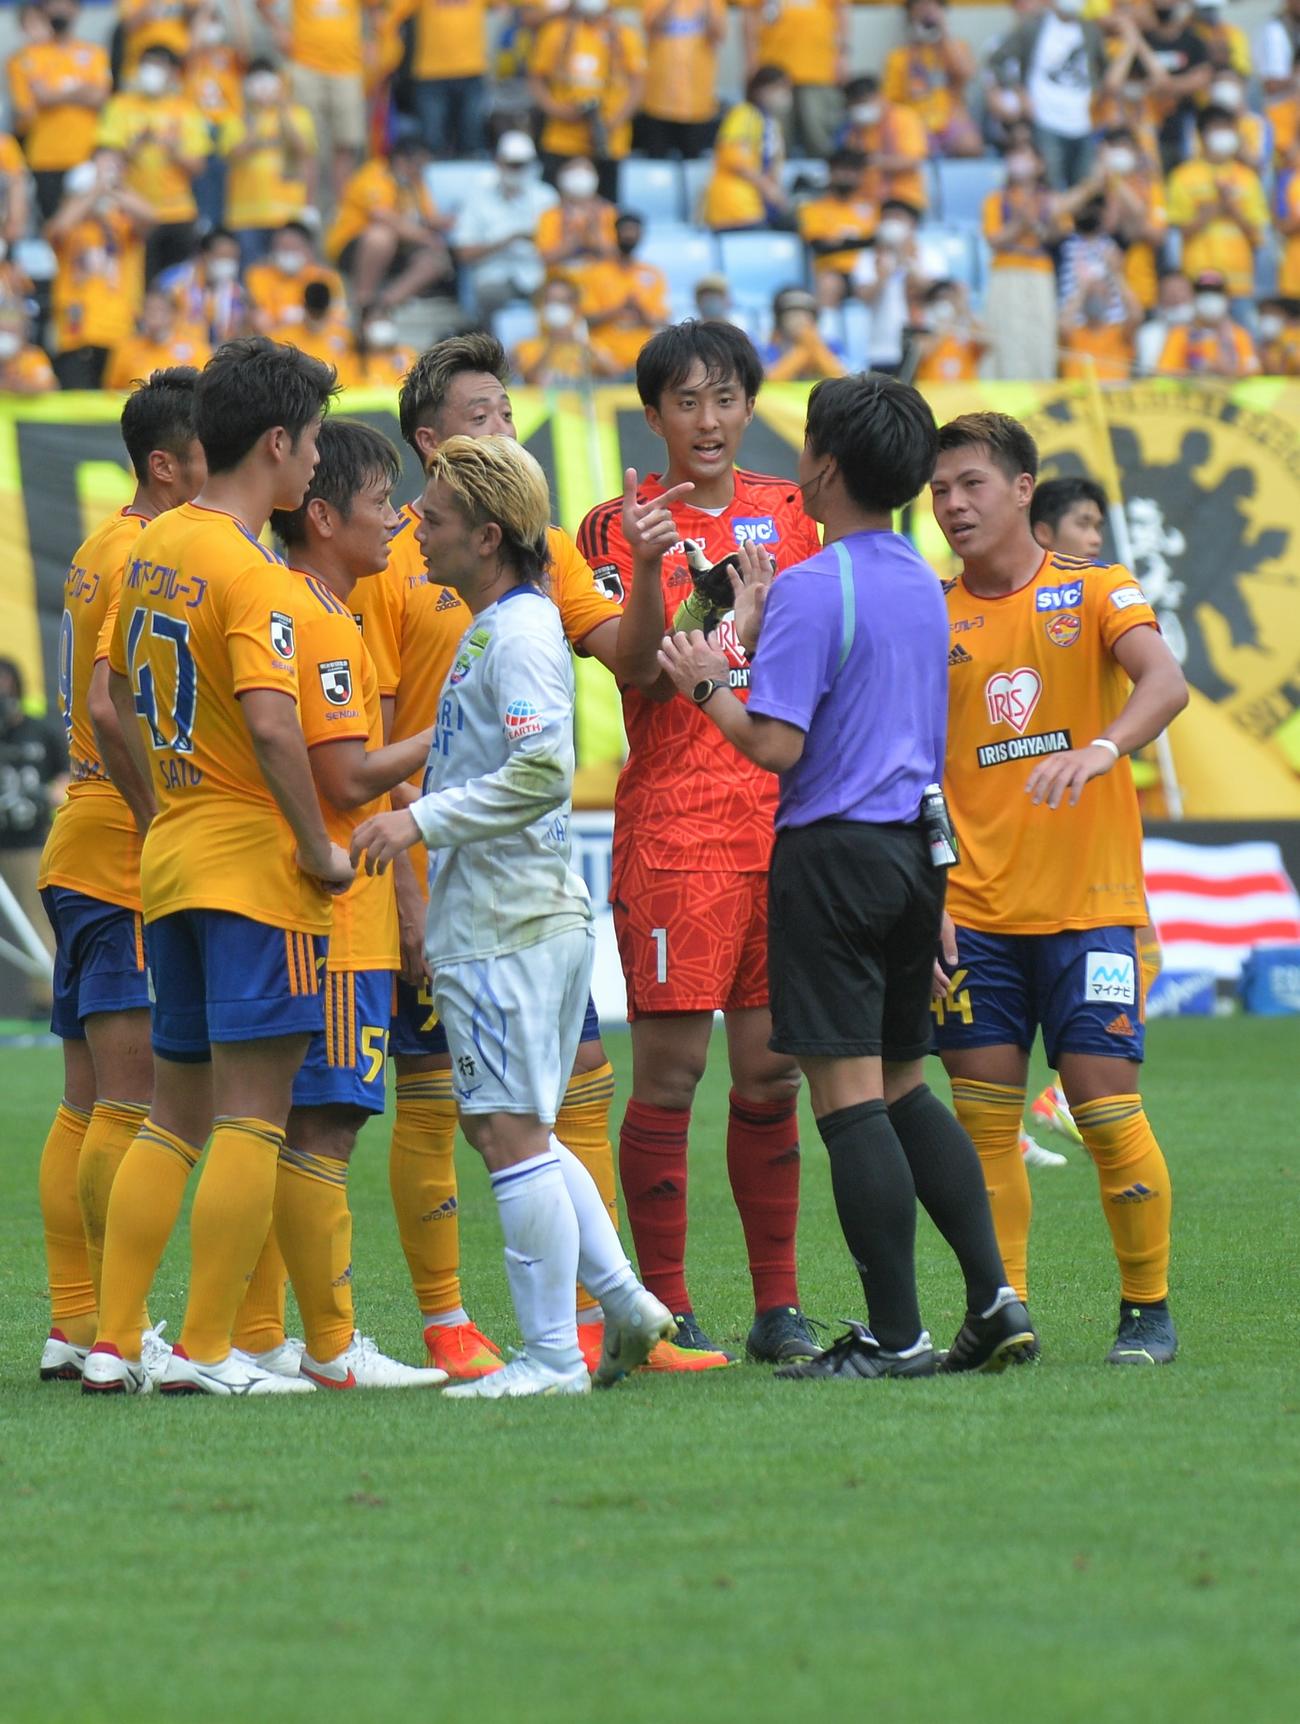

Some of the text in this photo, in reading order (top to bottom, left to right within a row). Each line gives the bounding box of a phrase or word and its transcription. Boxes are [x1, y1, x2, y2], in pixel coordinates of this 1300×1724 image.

[127, 606, 197, 754] 47
[988, 688, 1024, 723] IRIS
[508, 724, 541, 739] EARTH
[979, 732, 1069, 766] IRIS OHYAMA
[650, 927, 668, 984] 1
[1091, 983, 1131, 999] マイナビ
[361, 1025, 390, 1088] 5
